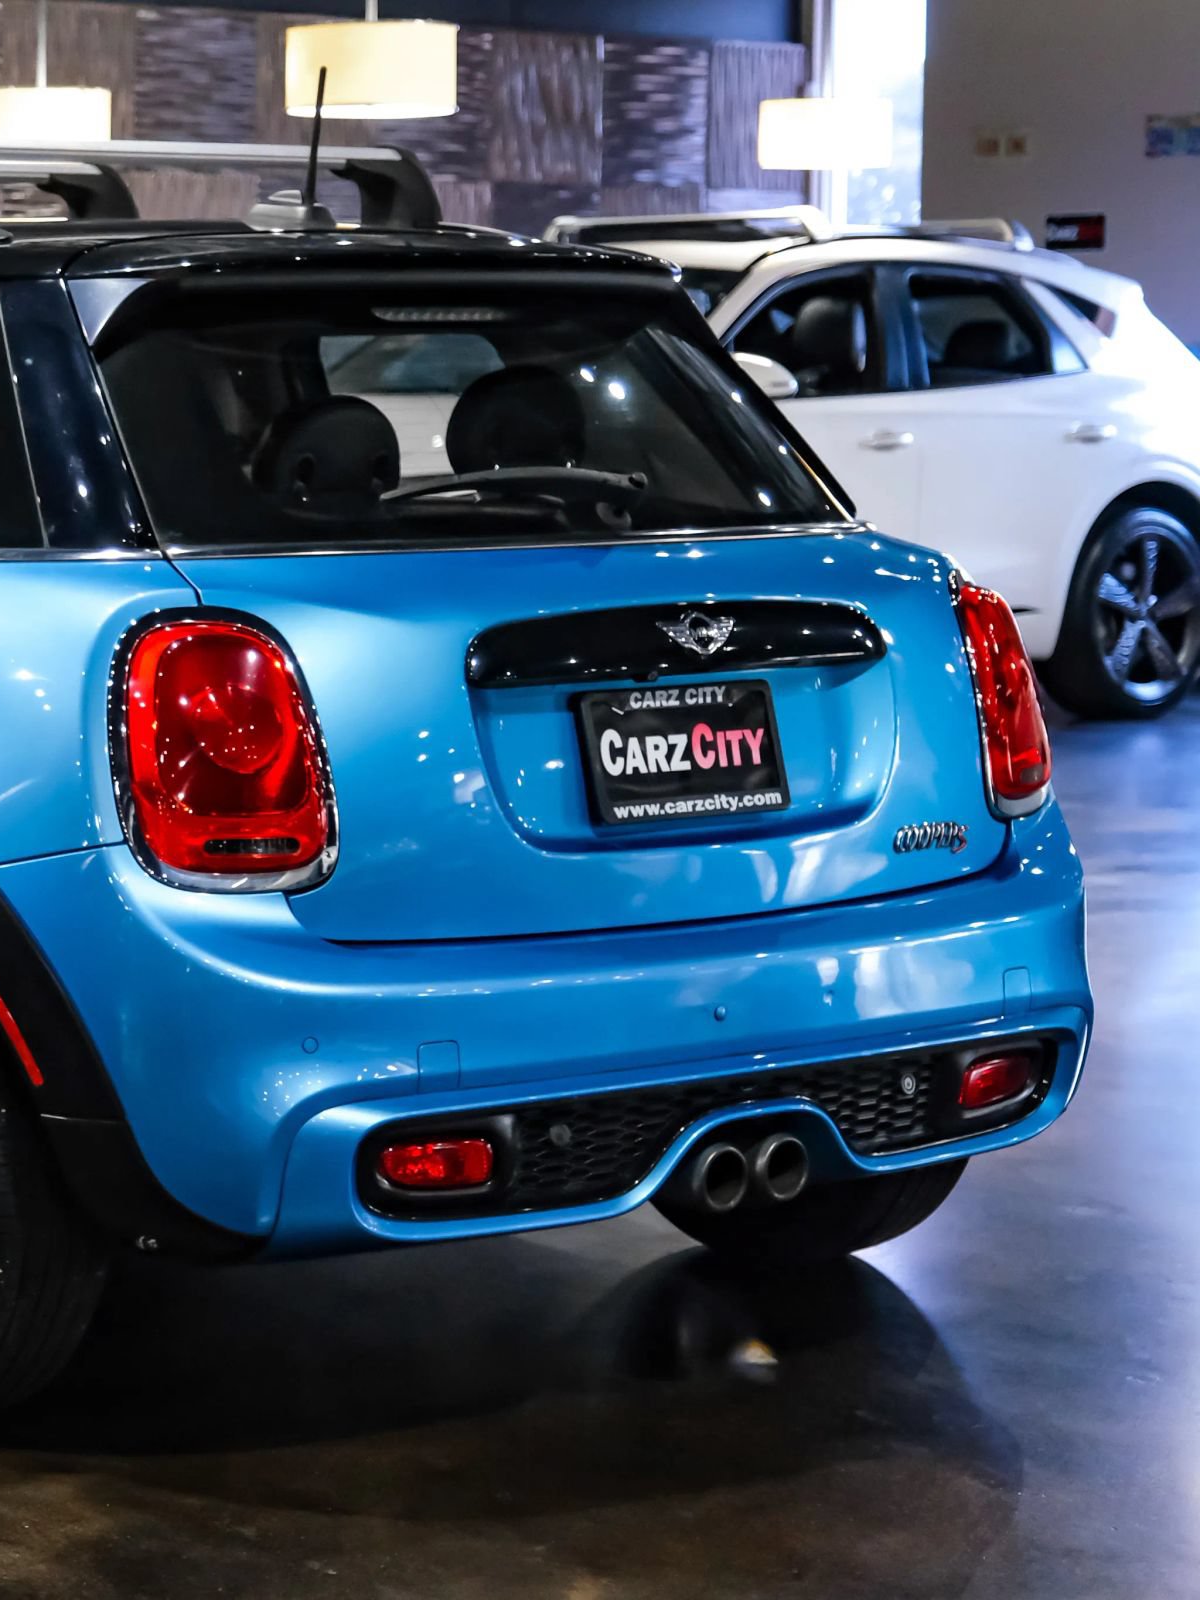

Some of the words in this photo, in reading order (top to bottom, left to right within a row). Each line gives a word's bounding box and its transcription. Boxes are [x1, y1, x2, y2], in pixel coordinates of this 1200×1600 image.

[629, 689, 680, 710] CARZ
[684, 686, 726, 705] CITY
[613, 791, 783, 820] www.carzcity.com
